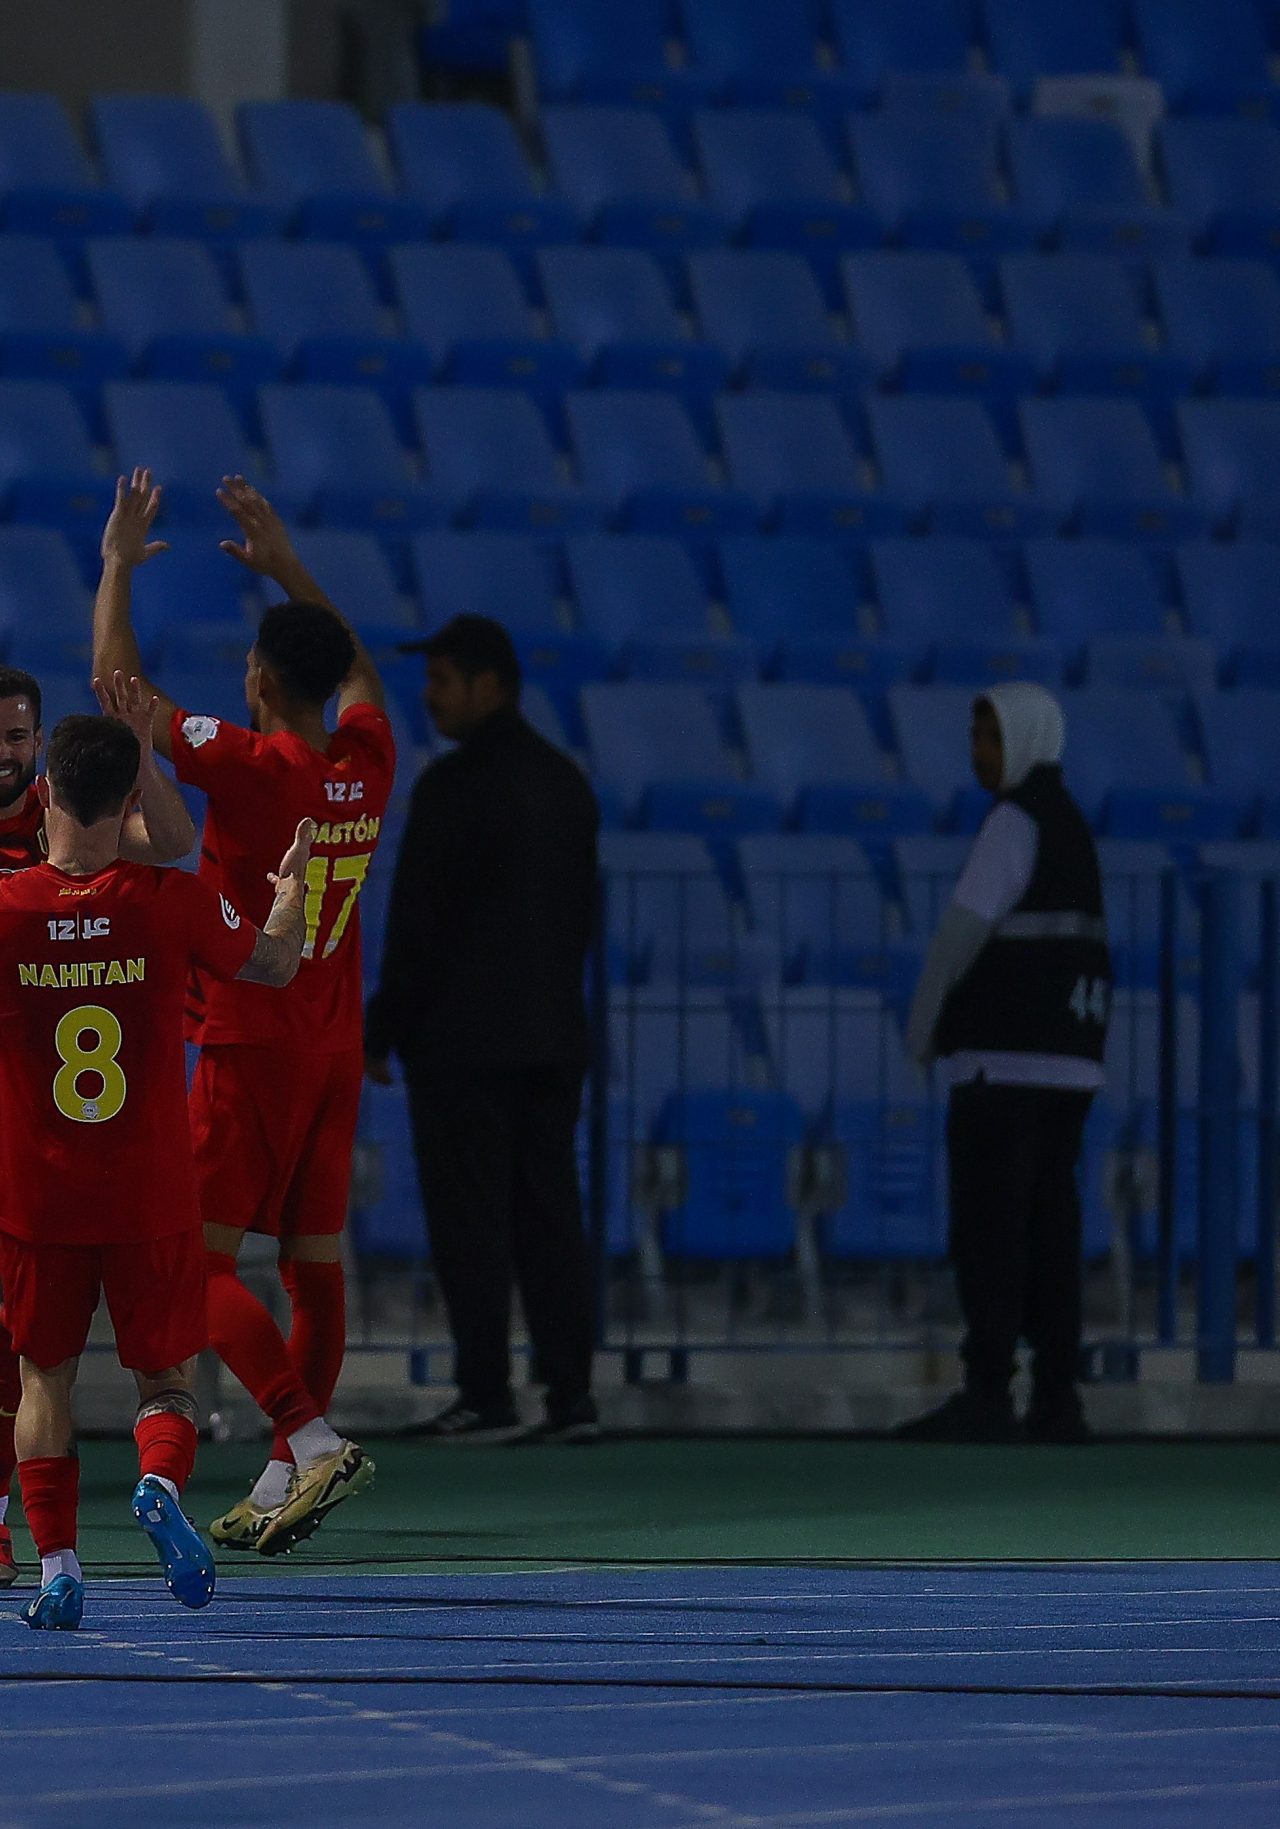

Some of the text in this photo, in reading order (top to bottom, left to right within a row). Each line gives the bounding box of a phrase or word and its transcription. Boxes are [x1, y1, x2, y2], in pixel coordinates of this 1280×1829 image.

[324, 782, 346, 802] 12
[302, 852, 372, 960] 17
[47, 919, 76, 941] 12
[17, 957, 146, 988] NAHITAN
[52, 1004, 128, 1123] 8
